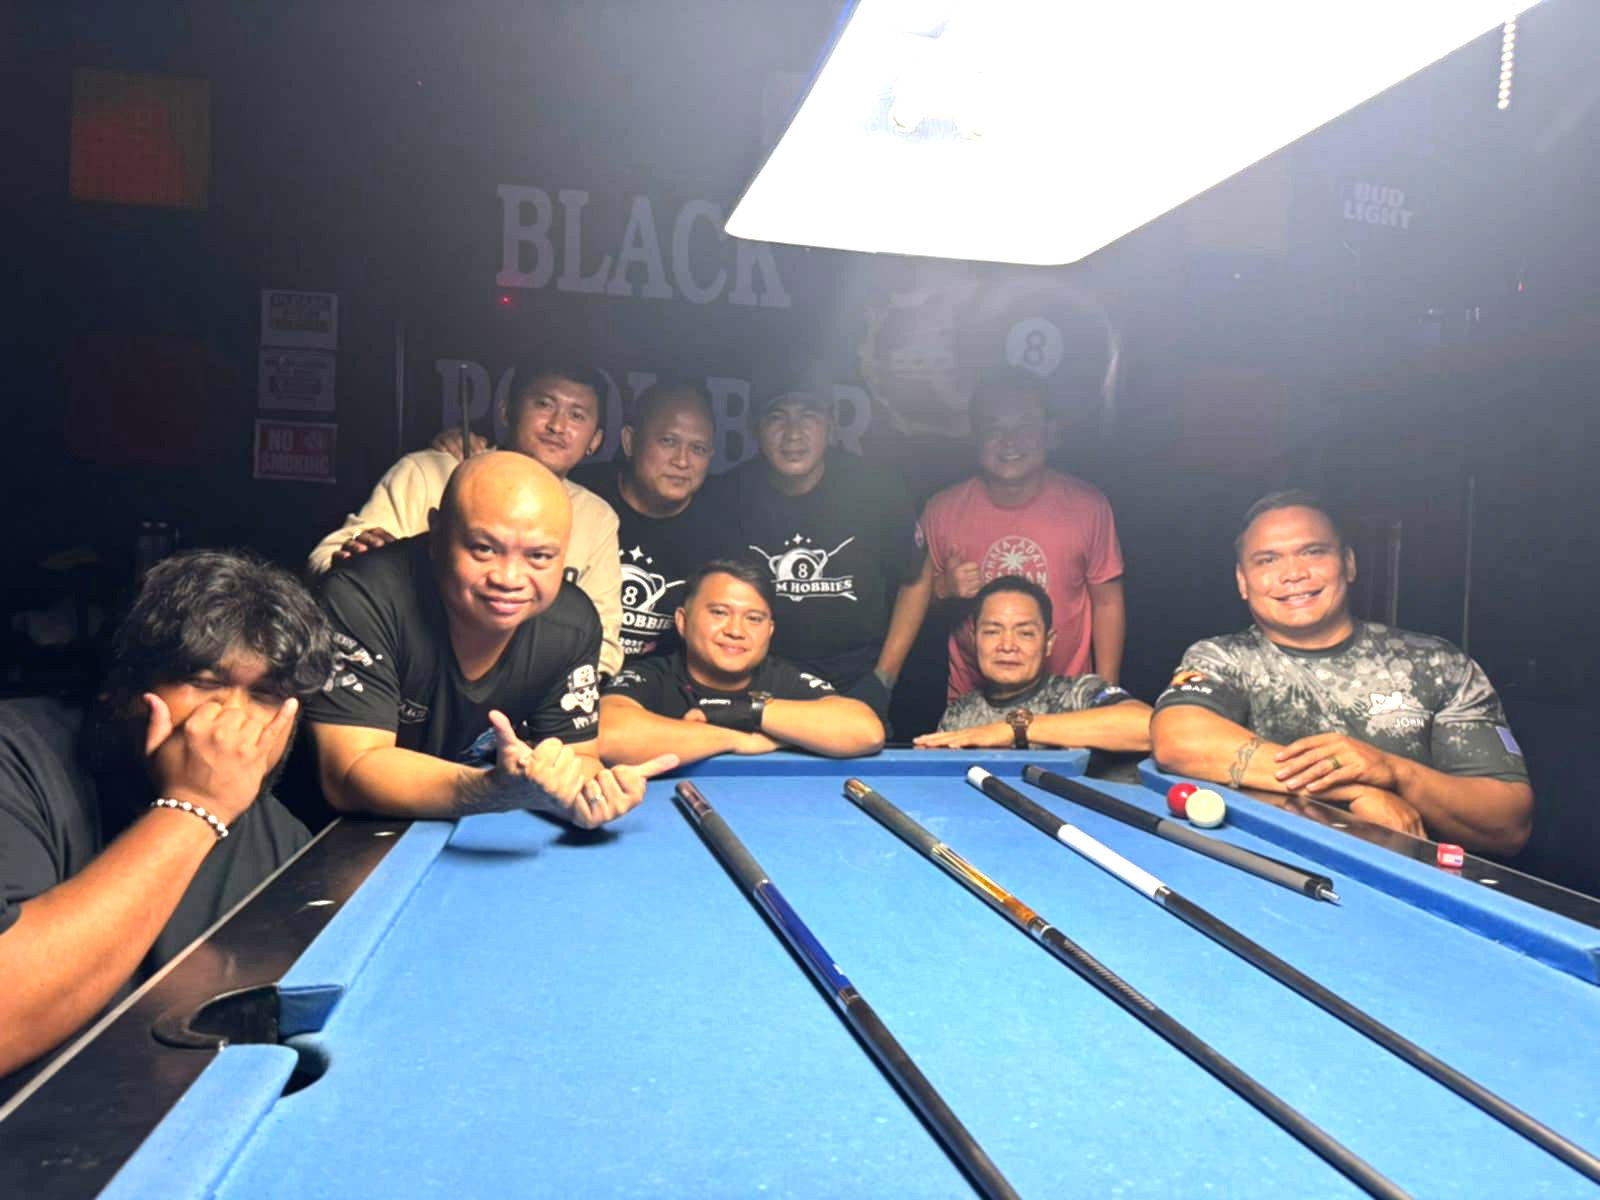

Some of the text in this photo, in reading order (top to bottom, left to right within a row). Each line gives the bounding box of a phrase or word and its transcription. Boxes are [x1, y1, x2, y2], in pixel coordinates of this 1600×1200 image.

[1353, 182, 1406, 208] BUD
[1343, 199, 1416, 231] LIGHT
[496, 183, 792, 309] BLACK
[1023, 330, 1048, 367] 8
[269, 429, 294, 452] NO
[258, 452, 329, 474] SMOKING
[797, 562, 809, 579] 8
[622, 586, 639, 606] 8
[790, 579, 854, 594] HOBBIES
[1394, 717, 1425, 729] JOHN
